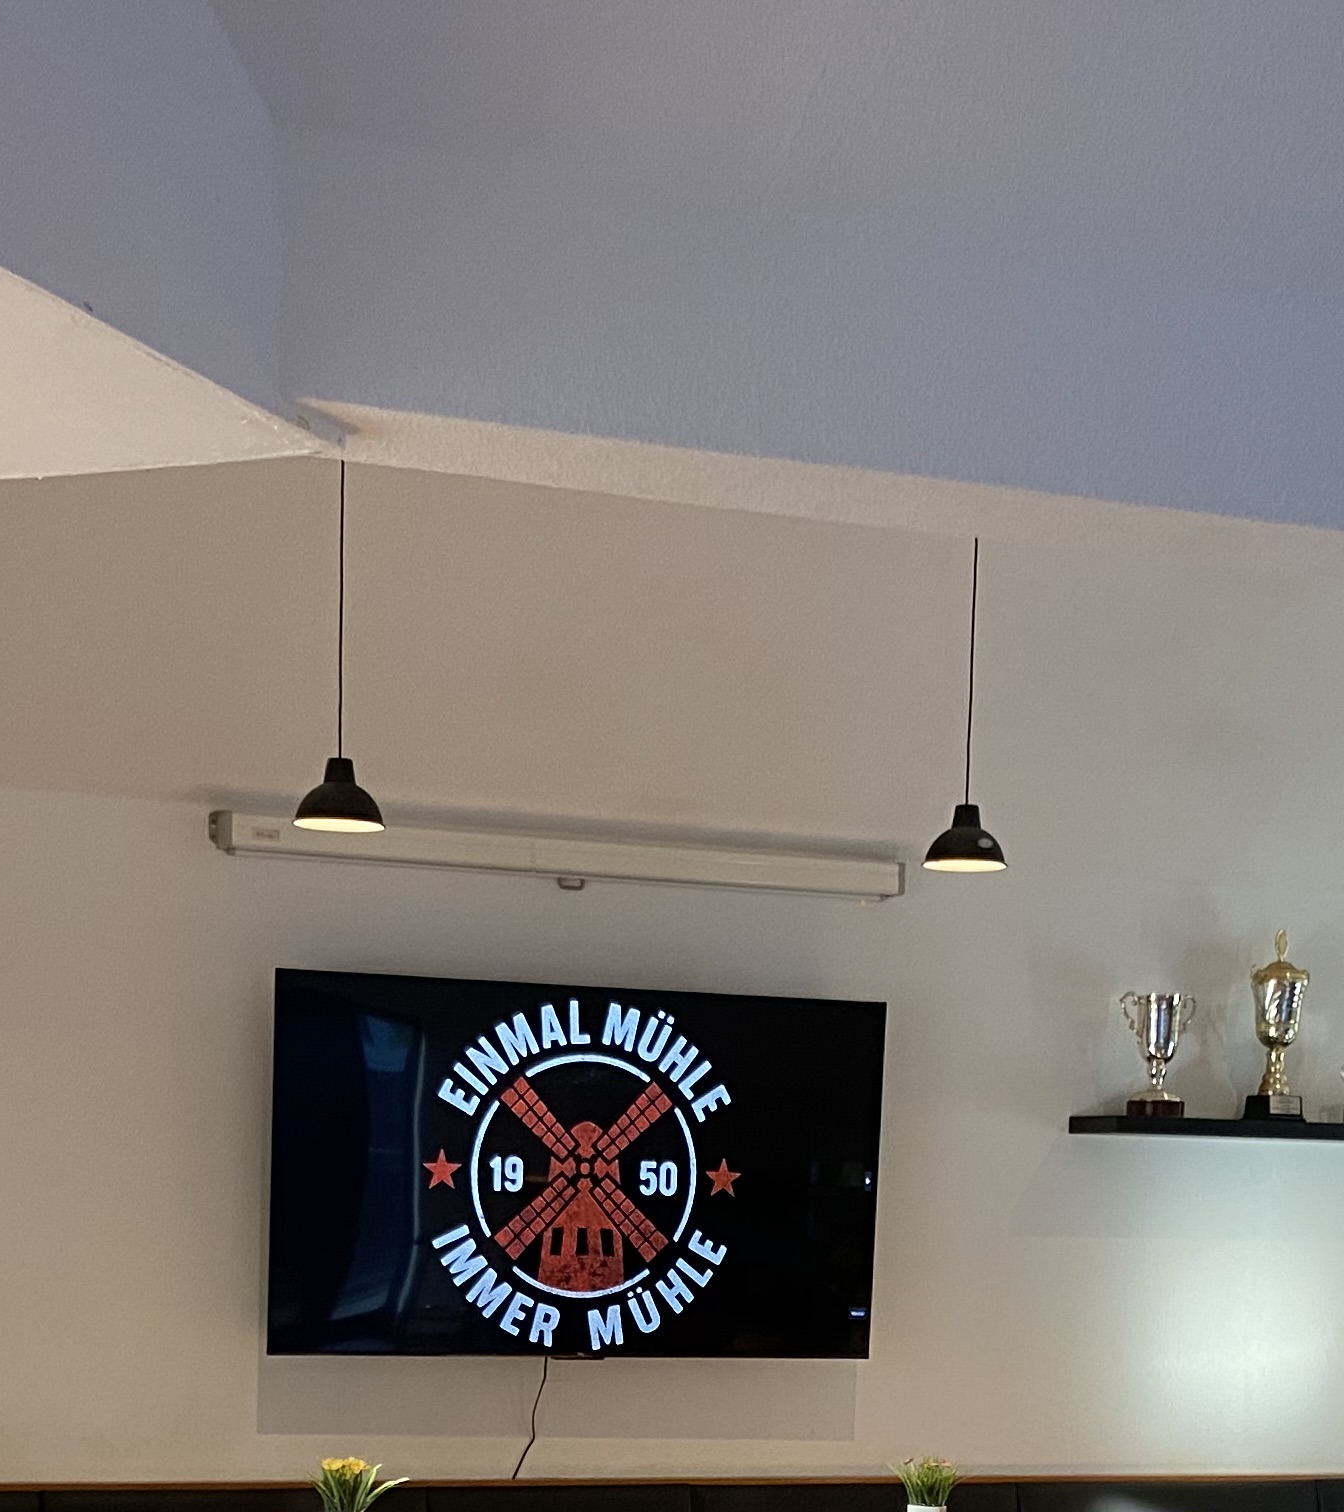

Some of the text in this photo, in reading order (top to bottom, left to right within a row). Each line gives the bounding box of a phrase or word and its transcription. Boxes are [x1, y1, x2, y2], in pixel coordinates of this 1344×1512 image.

[437, 999, 733, 1123] EINMAL MÜHLE
[489, 1155, 679, 1197] 19 50
[431, 1224, 729, 1351] IMMER MÜHLE
